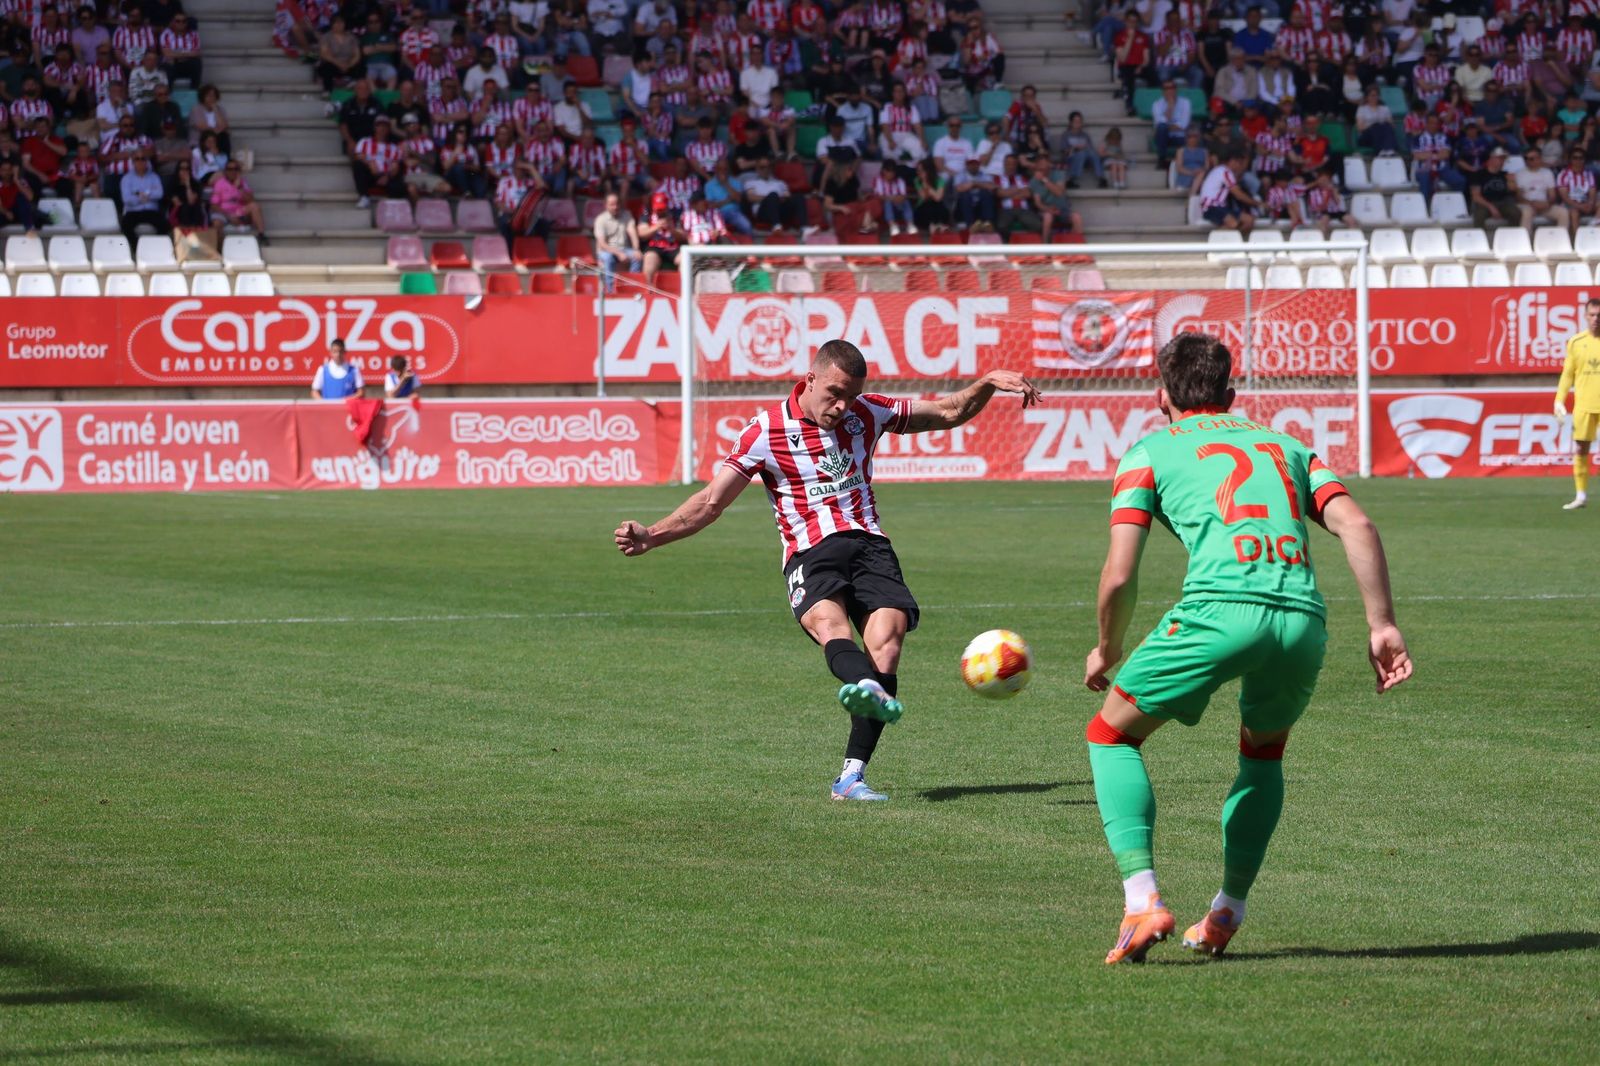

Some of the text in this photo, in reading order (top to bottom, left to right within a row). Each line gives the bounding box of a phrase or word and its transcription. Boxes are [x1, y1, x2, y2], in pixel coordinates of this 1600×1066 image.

[6, 323, 57, 341] Grupo
[1517, 291, 1590, 343] fisi
[7, 342, 109, 360] Leomotor
[903, 296, 1010, 376] CF
[1518, 336, 1568, 360] rea
[160, 356, 295, 372] EMBUTIDOS
[303, 356, 314, 370] Y
[76, 411, 240, 446] Carné Joven
[450, 408, 641, 444] Escuela
[78, 450, 270, 492] Castilla y León
[455, 447, 643, 485] infantil
[809, 473, 865, 497] CAJA RURAL
[1196, 442, 1301, 525] 21
[1232, 534, 1310, 568] DIGI
[788, 564, 804, 592] 14
